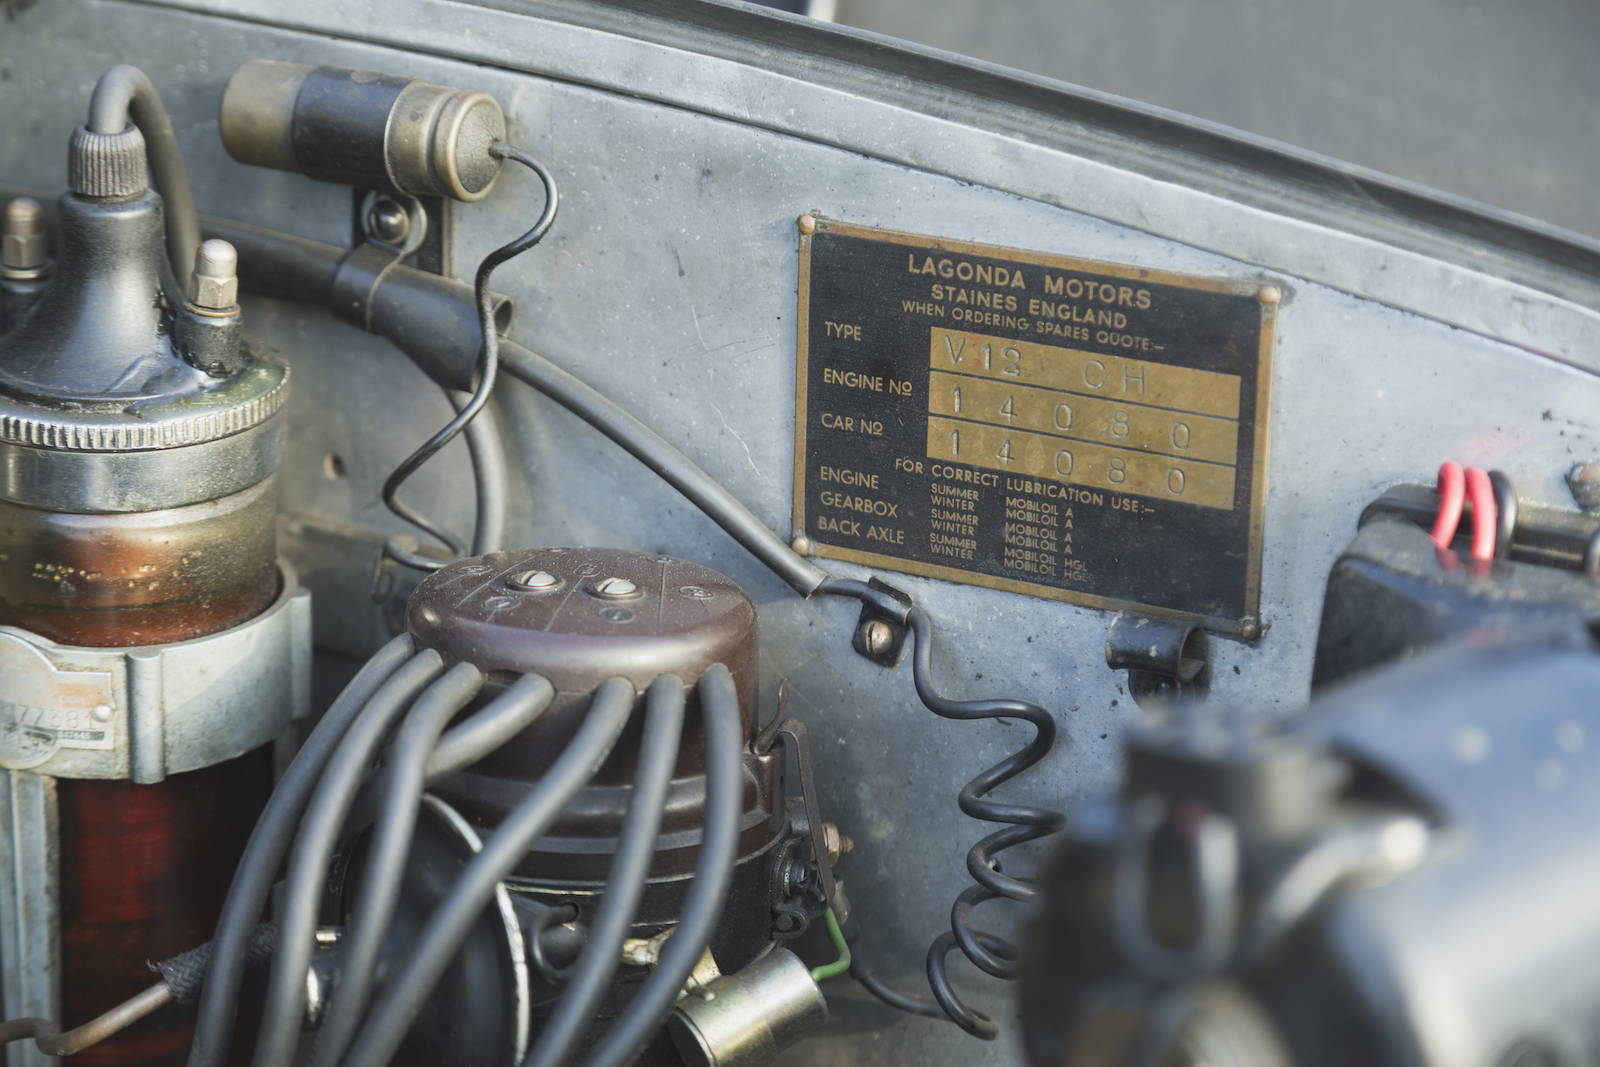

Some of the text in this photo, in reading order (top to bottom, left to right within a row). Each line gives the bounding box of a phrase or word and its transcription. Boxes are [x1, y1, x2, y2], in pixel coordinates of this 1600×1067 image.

[908, 254, 1152, 309] LAGONDA MOTORS
[902, 300, 945, 318] WHEN
[952, 307, 1030, 330] ORDERING
[1036, 321, 1090, 341] SPARES
[931, 284, 1128, 328] STAINES ENGLAND
[824, 321, 862, 341] TYPE
[824, 368, 883, 392] ENGINE
[821, 413, 854, 432] CAR
[820, 466, 879, 490] ENGINE
[895, 458, 923, 474] FOR
[932, 465, 999, 487] CORRECT
[1006, 478, 1103, 506] LUBRICATION
[820, 491, 898, 518] GEARBOX
[930, 495, 1074, 529] WINTER MOBILOIL A
[931, 483, 1074, 518] SUMMER MOBILOIL A
[818, 516, 905, 545] BACK AXLE
[930, 519, 1073, 555] WINTER MOBILOIL A
[931, 508, 1073, 544] SUMMER MOBILOIL A
[930, 533, 1088, 572] SUMMER MOBILOIL HGL
[930, 543, 974, 560] WINTER
[1004, 558, 1057, 577] MOBILOIL
